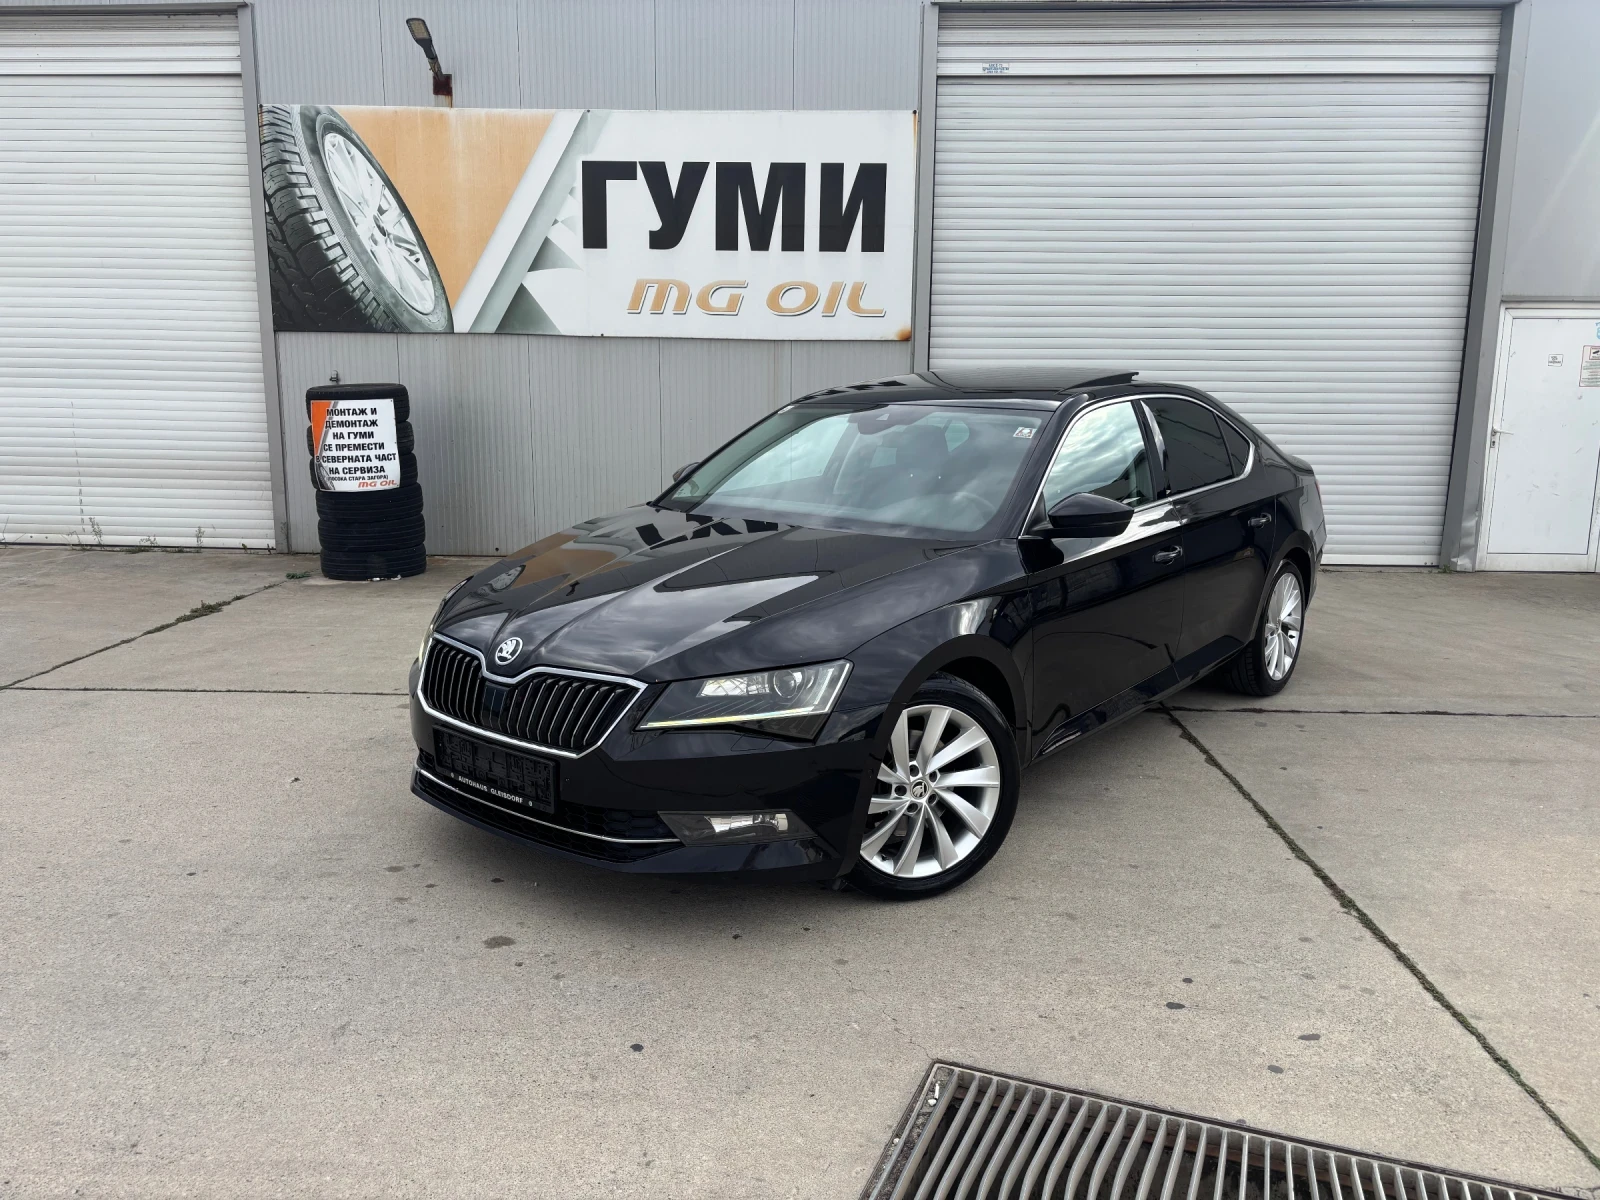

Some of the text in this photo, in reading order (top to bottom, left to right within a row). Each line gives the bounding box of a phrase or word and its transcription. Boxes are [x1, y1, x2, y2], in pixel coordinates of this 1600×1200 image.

[582, 160, 887, 253] ГУМИ
[626, 278, 886, 317] MG OIL
[326, 407, 378, 417] МОНТАЖ И
[325, 419, 379, 430] ДЕМОНТАЖ
[332, 431, 375, 440] НА ГУМИ
[323, 442, 385, 452] СЕ ПРЕМЕСТИ
[316, 453, 397, 464] В СЕВЕРНАТА ЧАСТ
[328, 465, 386, 475] НА СЕРВИЗА
[358, 480, 377, 488] MG
[458, 776, 523, 804] AUTOHAUS GLEISDORF
